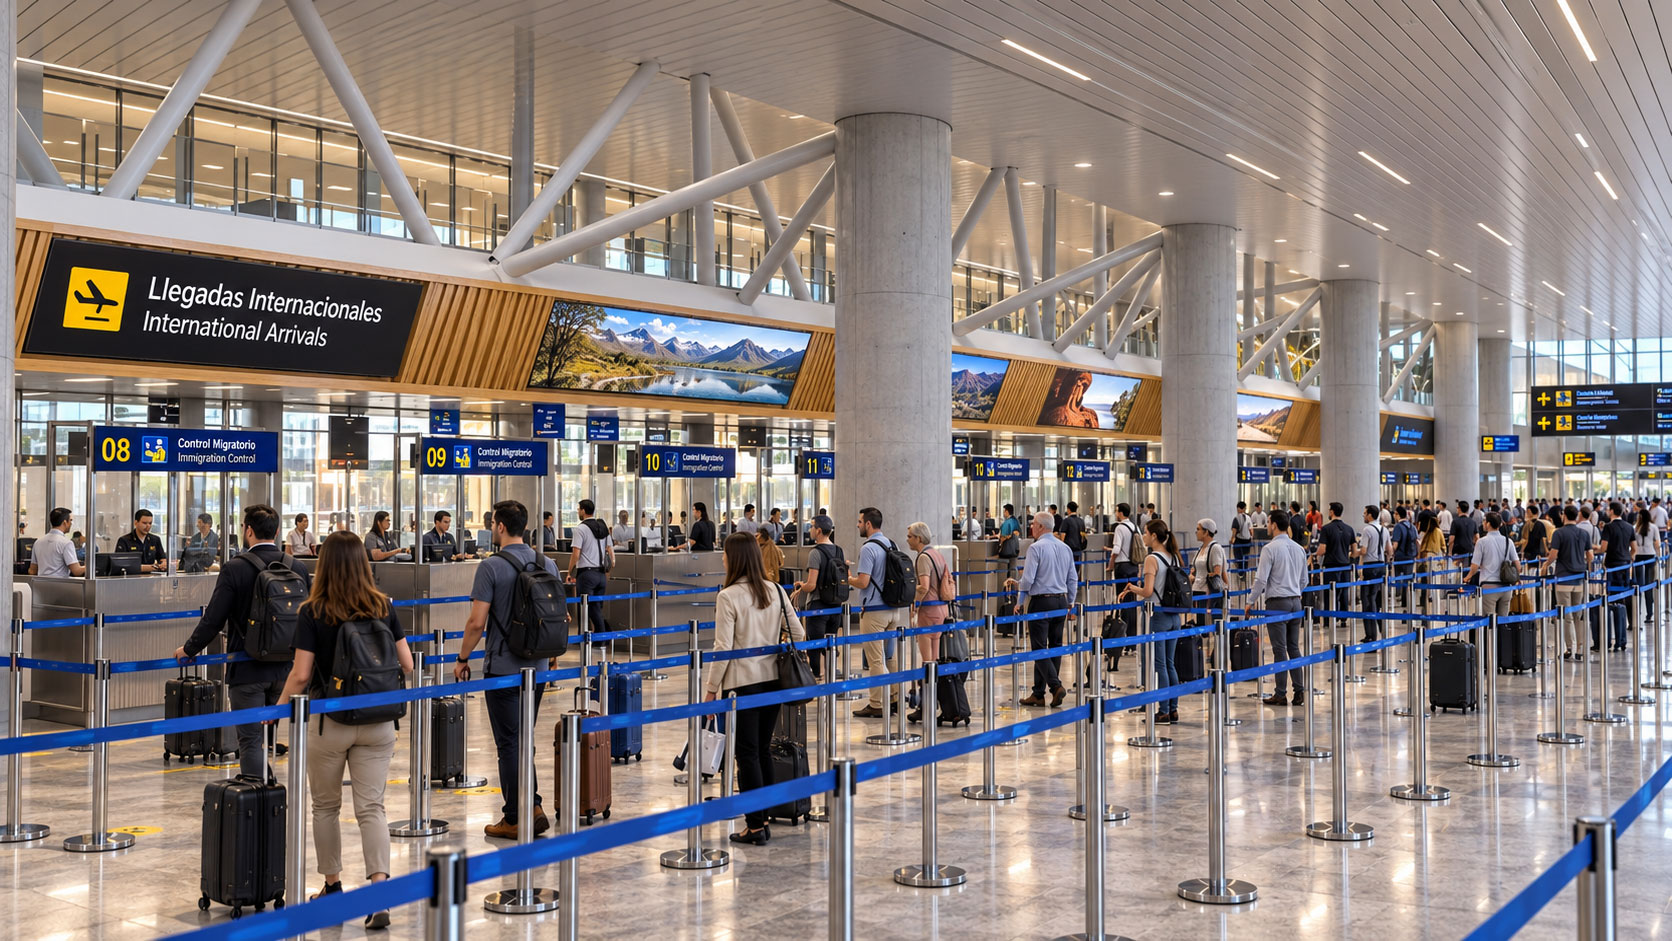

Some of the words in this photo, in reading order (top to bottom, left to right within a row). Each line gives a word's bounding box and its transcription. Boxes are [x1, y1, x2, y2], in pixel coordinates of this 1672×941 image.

[147, 276, 244, 309] Llegadas
[248, 287, 383, 323] Internacionales
[142, 310, 262, 342] International
[264, 321, 328, 348] Arrivals
[101, 436, 131, 463] 08
[178, 437, 211, 449] Control
[212, 438, 256, 452] Migratorio
[178, 452, 226, 465] Immigration
[228, 453, 256, 463] Control
[426, 446, 447, 468] 09
[645, 453, 660, 471] 10
[807, 457, 818, 474] 11
[975, 463, 984, 476] 10
